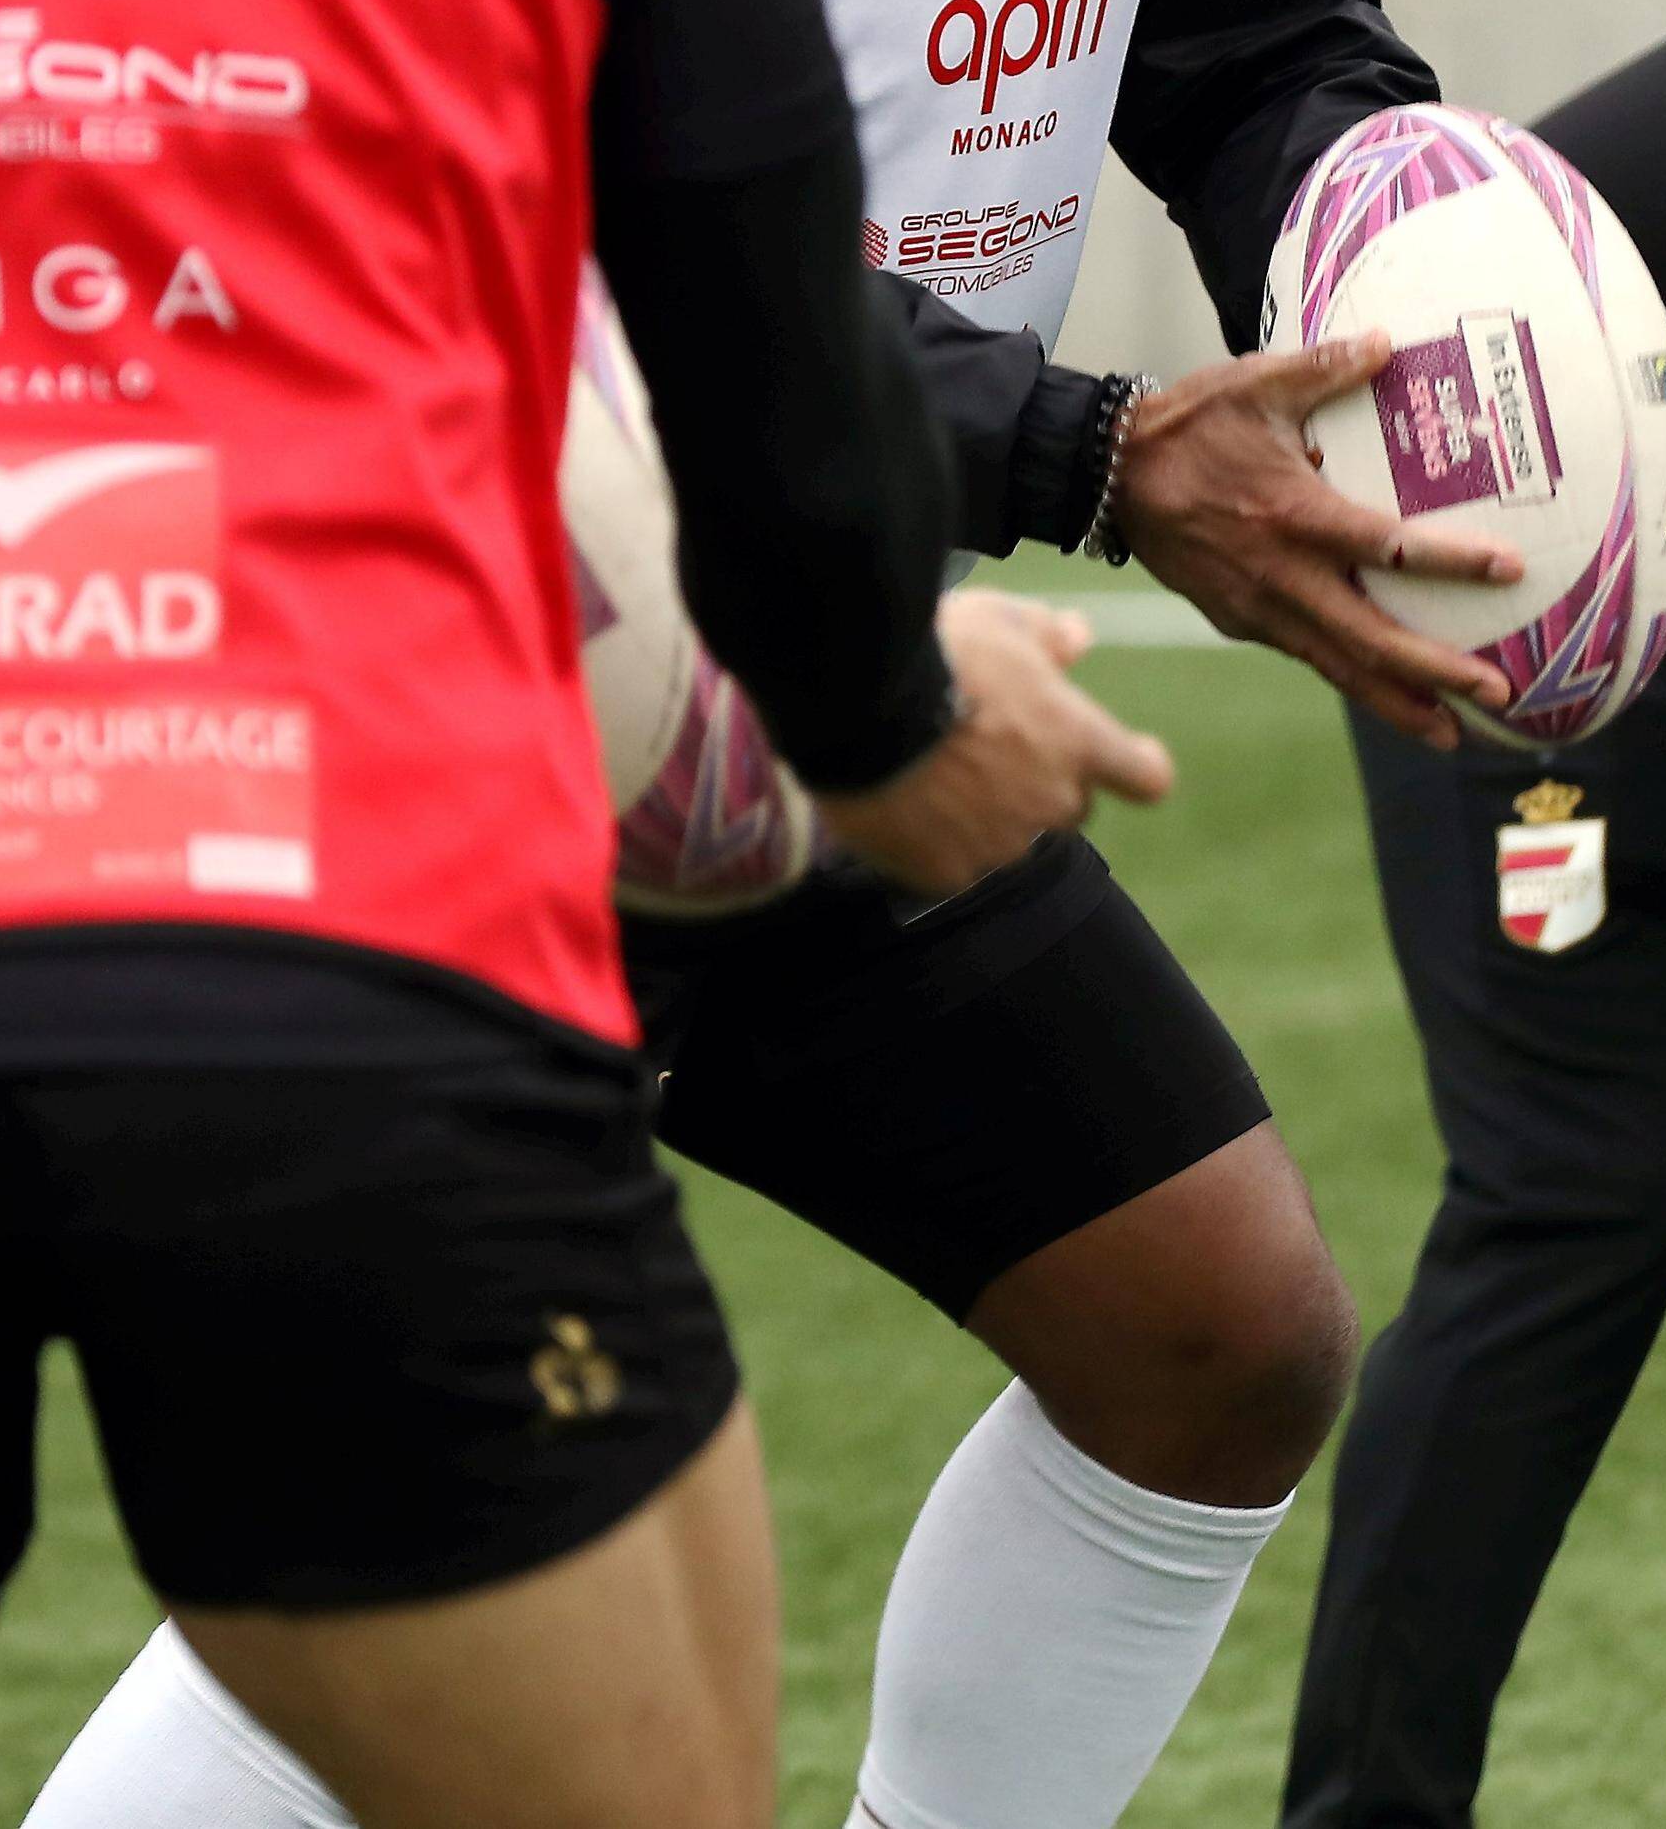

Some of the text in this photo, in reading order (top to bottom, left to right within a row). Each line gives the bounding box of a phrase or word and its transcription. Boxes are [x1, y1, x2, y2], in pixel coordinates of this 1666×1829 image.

[950, 109, 1058, 157] MONACO
[897, 194, 1079, 268] SEGOND
[900, 200, 1020, 232] GROUPE
